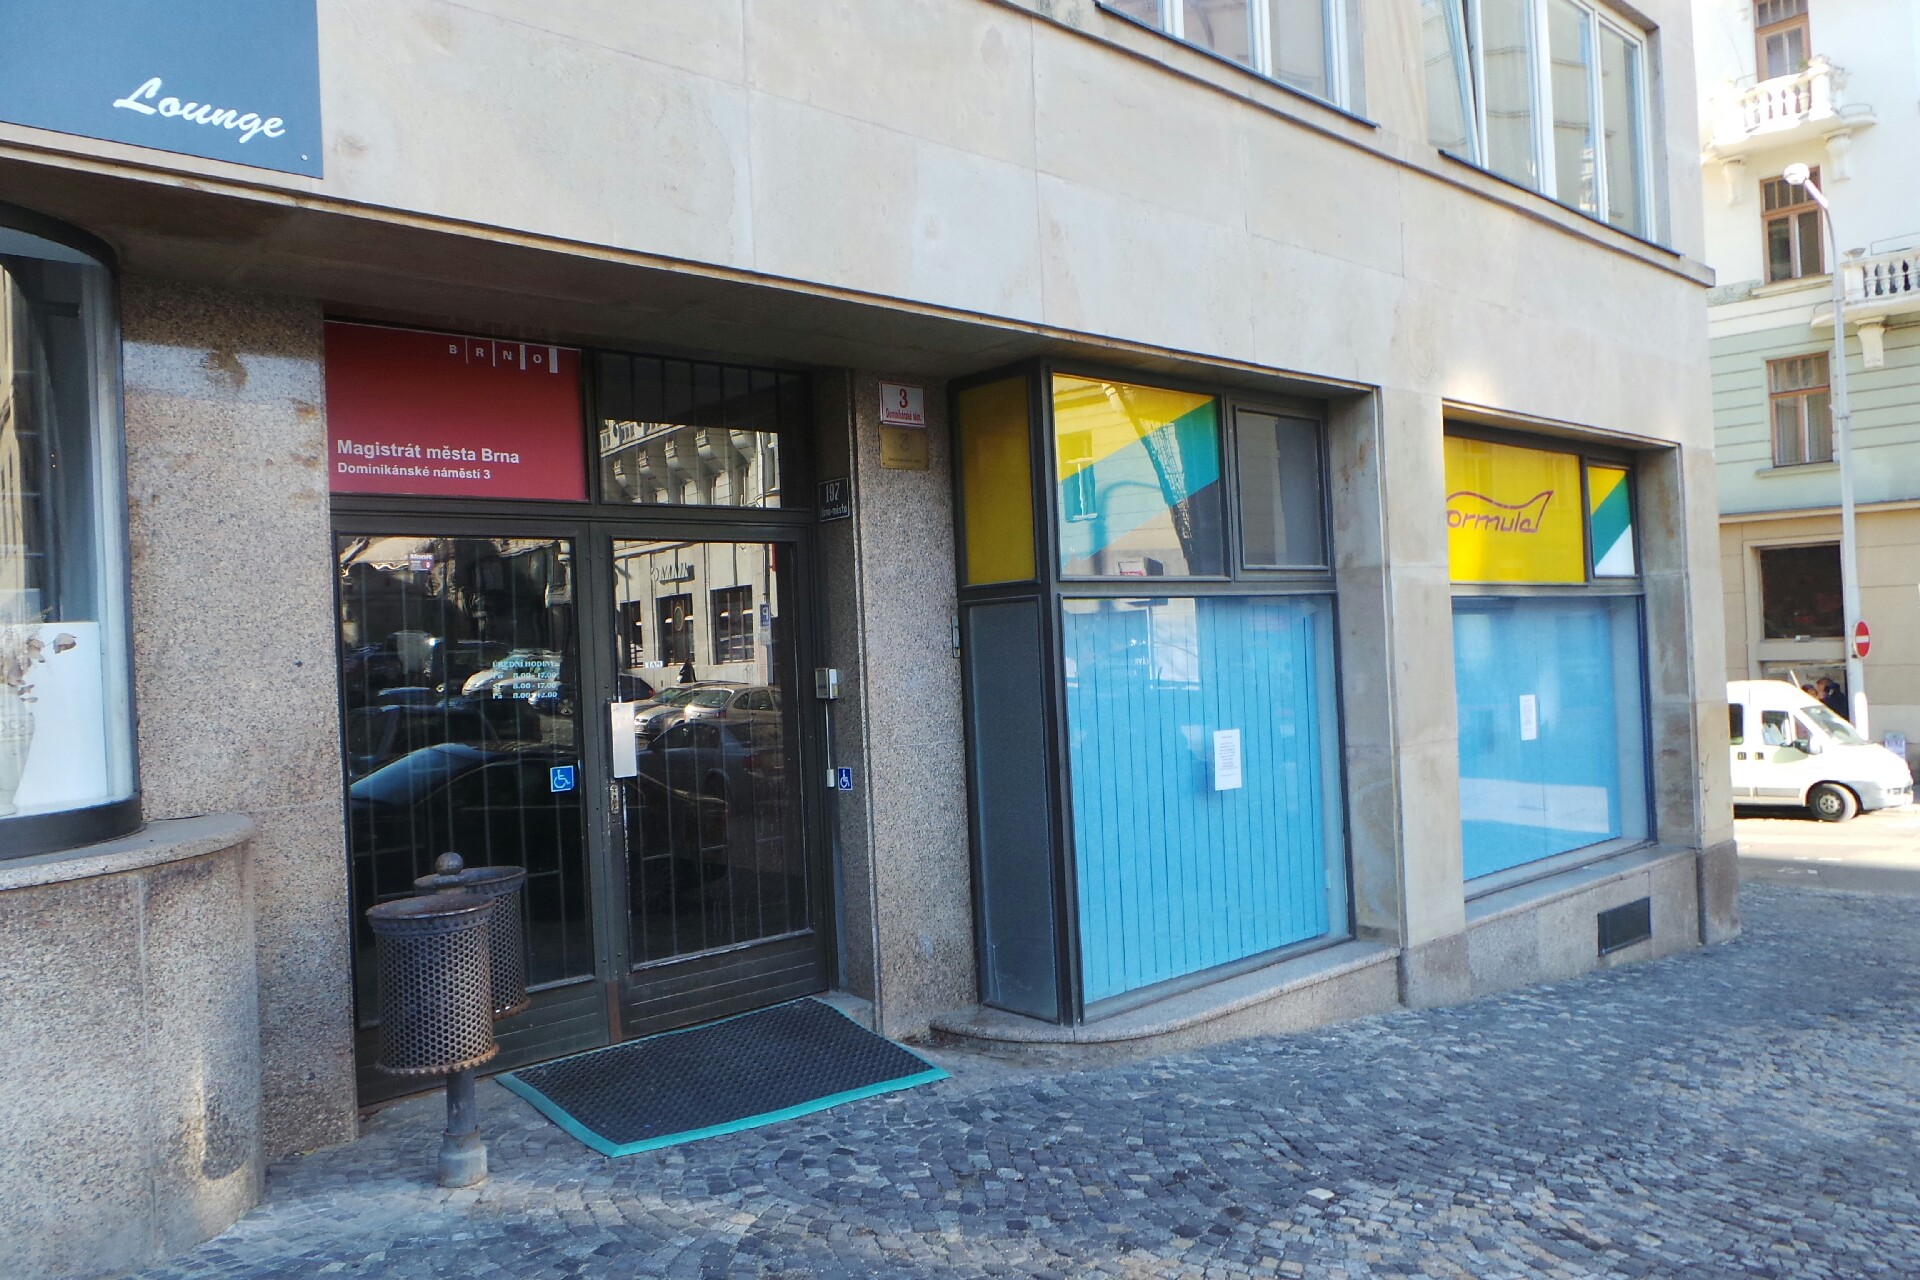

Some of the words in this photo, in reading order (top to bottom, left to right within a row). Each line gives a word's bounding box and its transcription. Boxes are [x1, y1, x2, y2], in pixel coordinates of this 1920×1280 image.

[113, 77, 286, 144] Lounge
[448, 344, 543, 364] BRNO
[899, 388, 909, 409] 3
[337, 439, 421, 459] Magistrát
[426, 445, 477, 462] města
[481, 448, 520, 464] Brna
[337, 462, 430, 477] Dominikánské
[433, 467, 481, 480] náměstí
[483, 469, 491, 480] 3
[825, 482, 841, 503] 197
[1446, 506, 1540, 534] ormula
